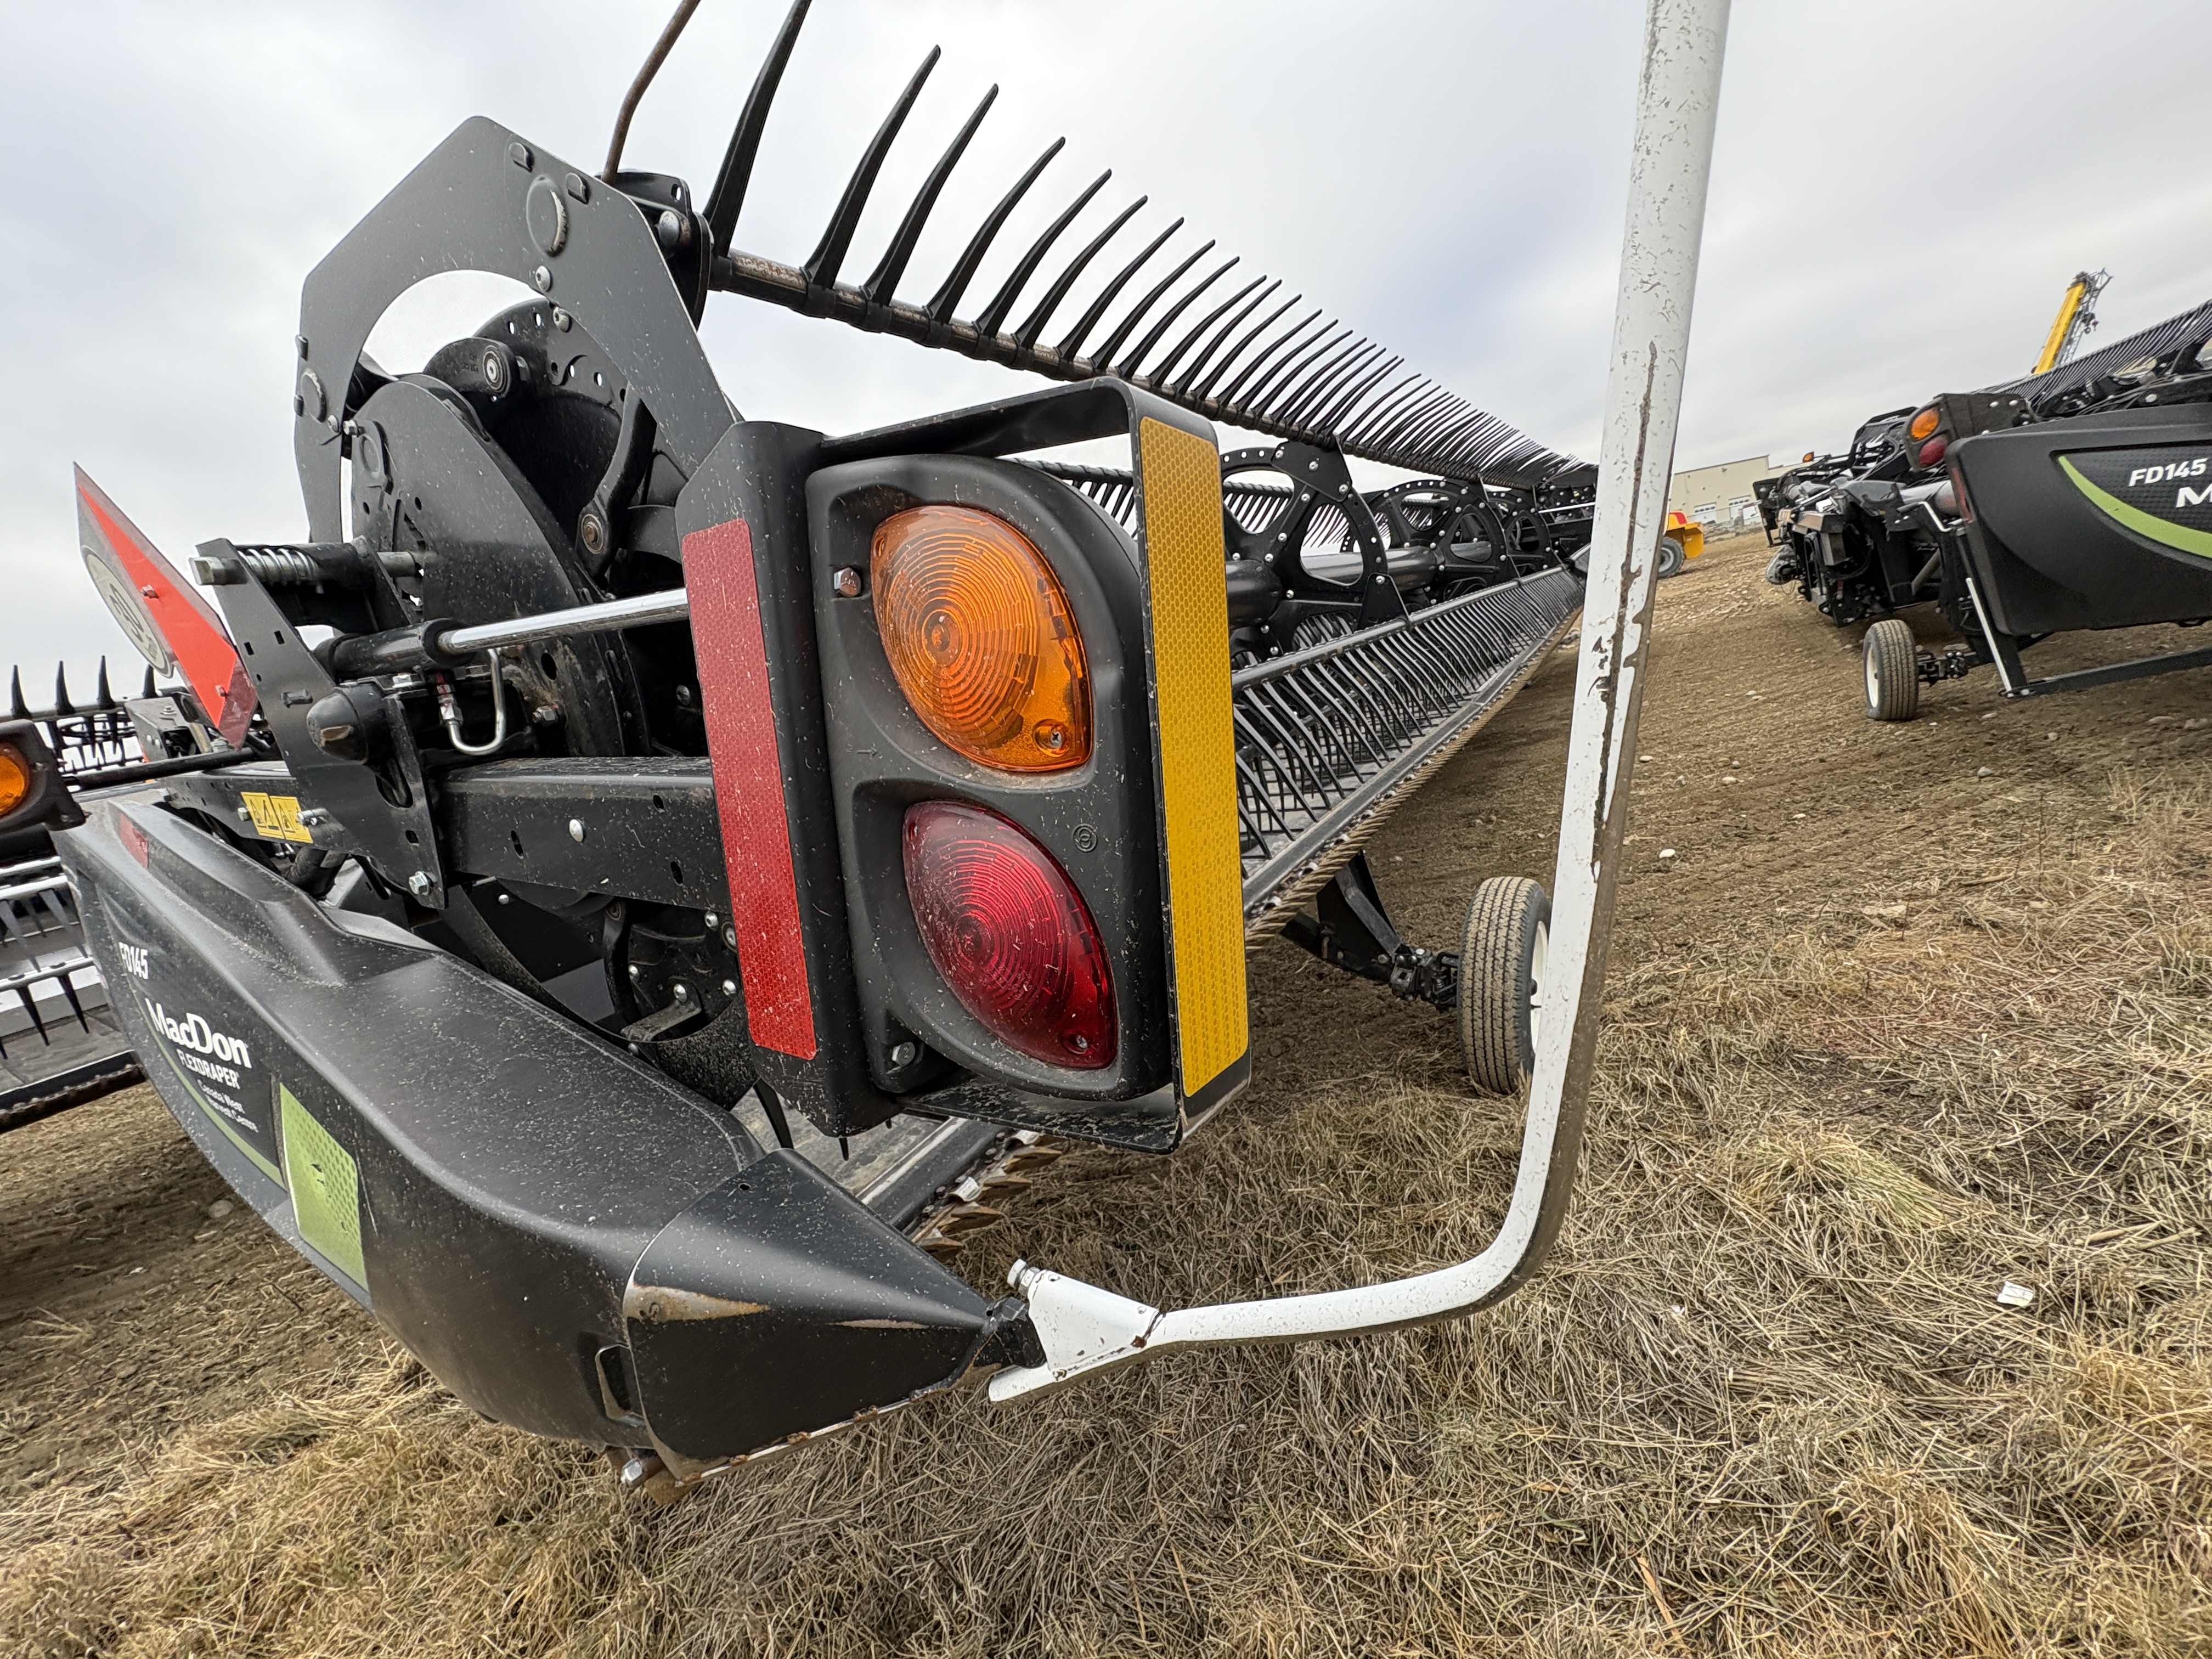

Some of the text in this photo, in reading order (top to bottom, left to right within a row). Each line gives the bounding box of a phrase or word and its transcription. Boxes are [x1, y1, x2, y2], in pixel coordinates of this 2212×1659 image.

[2129, 458, 2209, 487] FD145
[119, 941, 149, 979] FD145
[144, 997, 252, 1069] MacDon
[176, 1048, 241, 1090] FLEXDRAPER
